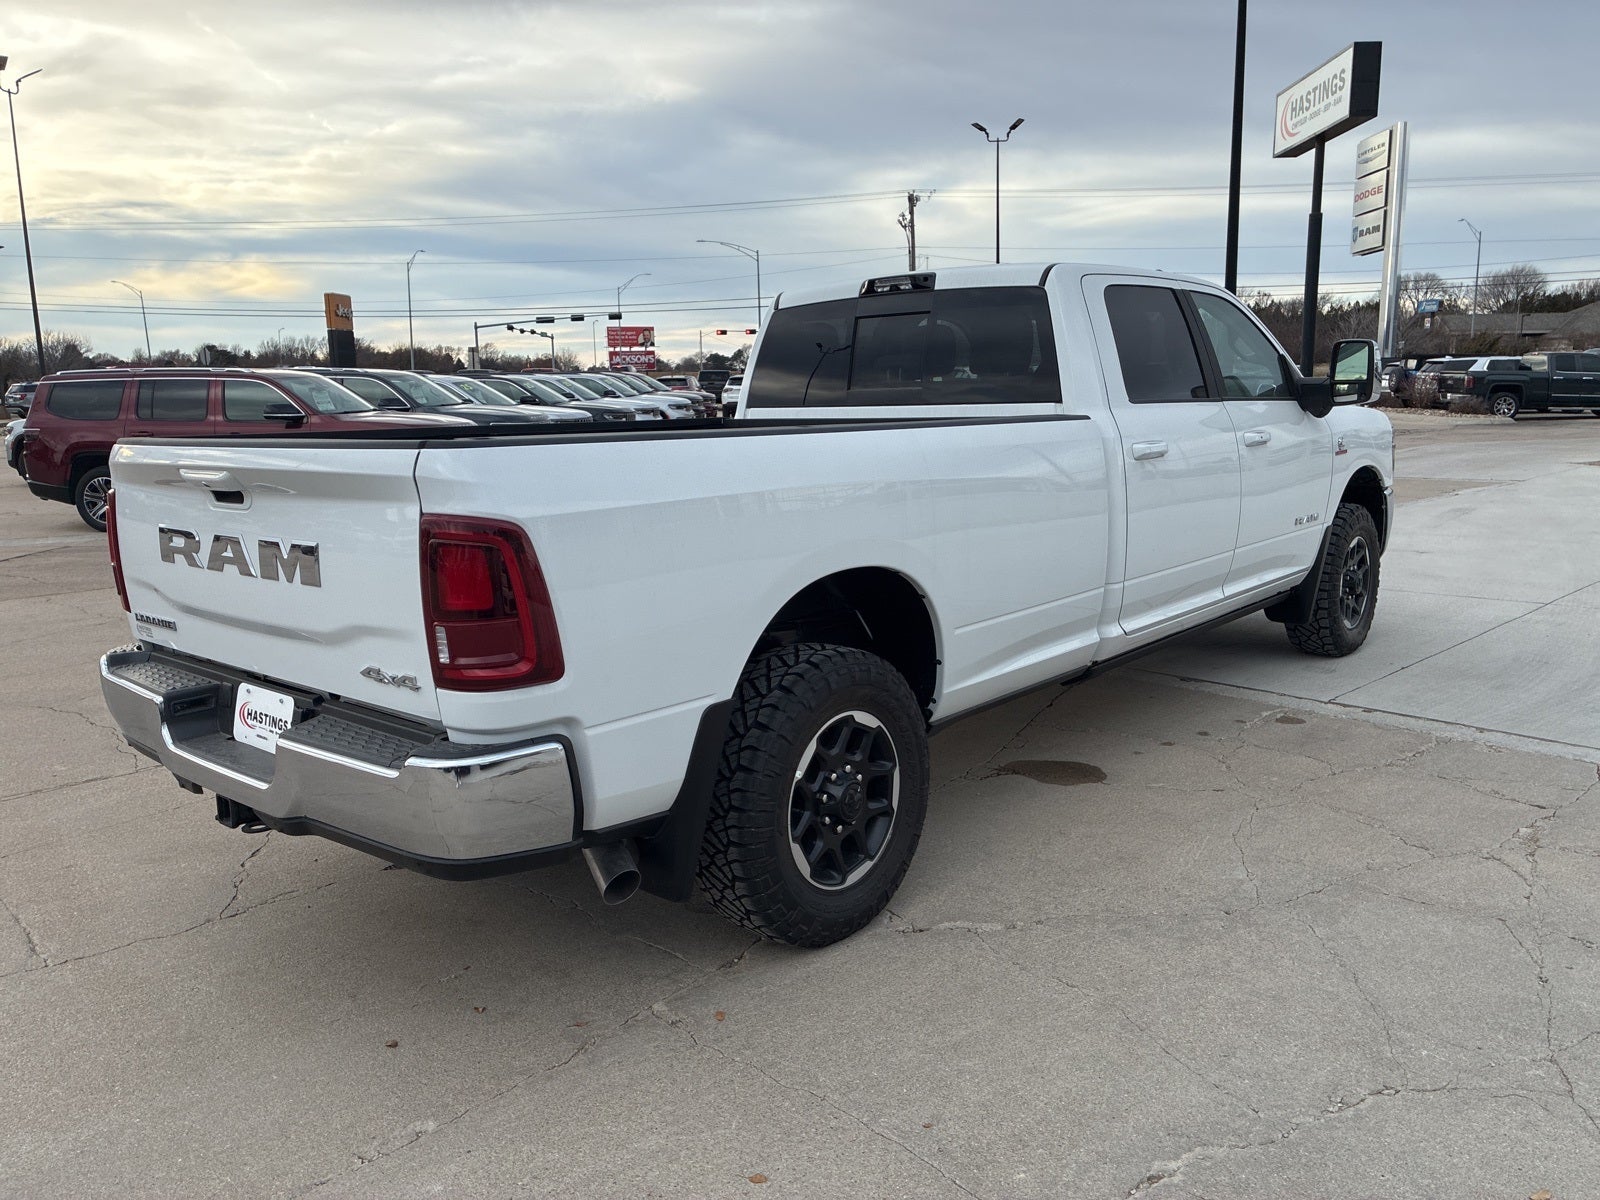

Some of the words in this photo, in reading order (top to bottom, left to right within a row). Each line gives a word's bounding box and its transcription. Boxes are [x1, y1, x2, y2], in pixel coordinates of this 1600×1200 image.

[1290, 68, 1346, 120] HASTINGS
[1357, 142, 1386, 158] CHRYSLER
[1354, 184, 1383, 203] DODGE
[1358, 224, 1381, 238] RAM
[335, 303, 353, 321] Jeep
[611, 355, 654, 364] JACKSON'S
[158, 523, 322, 588] RAM
[135, 612, 177, 631] LARAMIE
[246, 707, 288, 732] HASTINGS
